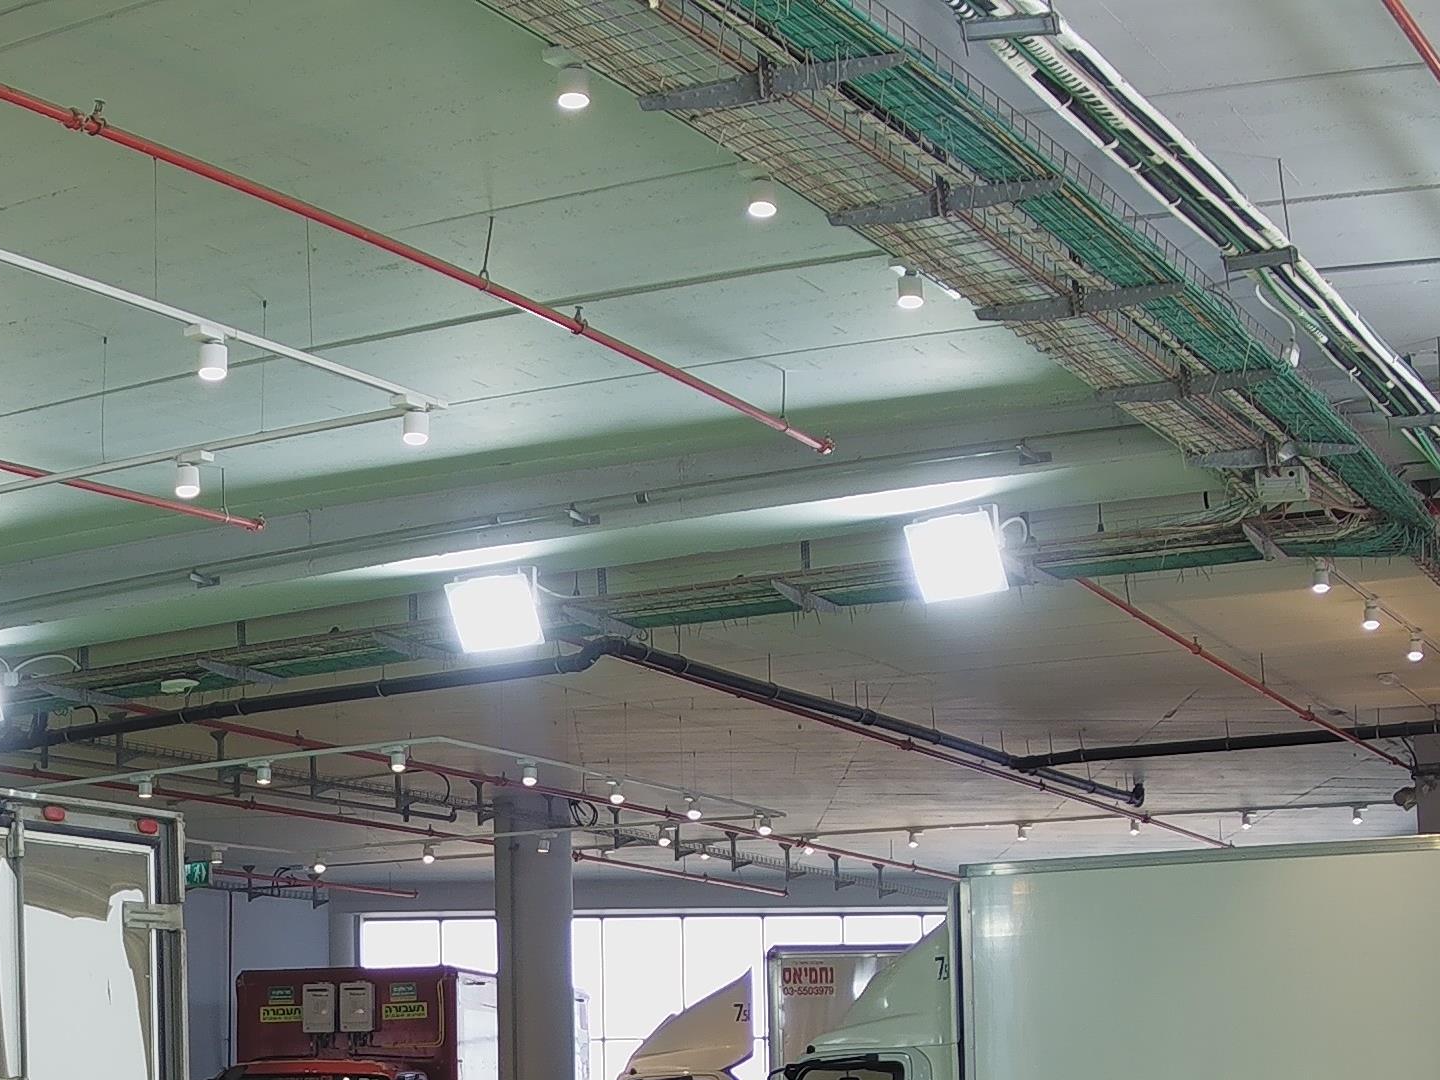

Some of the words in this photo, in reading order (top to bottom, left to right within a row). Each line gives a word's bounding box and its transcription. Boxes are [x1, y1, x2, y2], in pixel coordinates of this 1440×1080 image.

[782, 966, 834, 984] נחמיאס
[782, 986, 834, 996] 03-5503979
[385, 1004, 425, 1013] תעבורה
